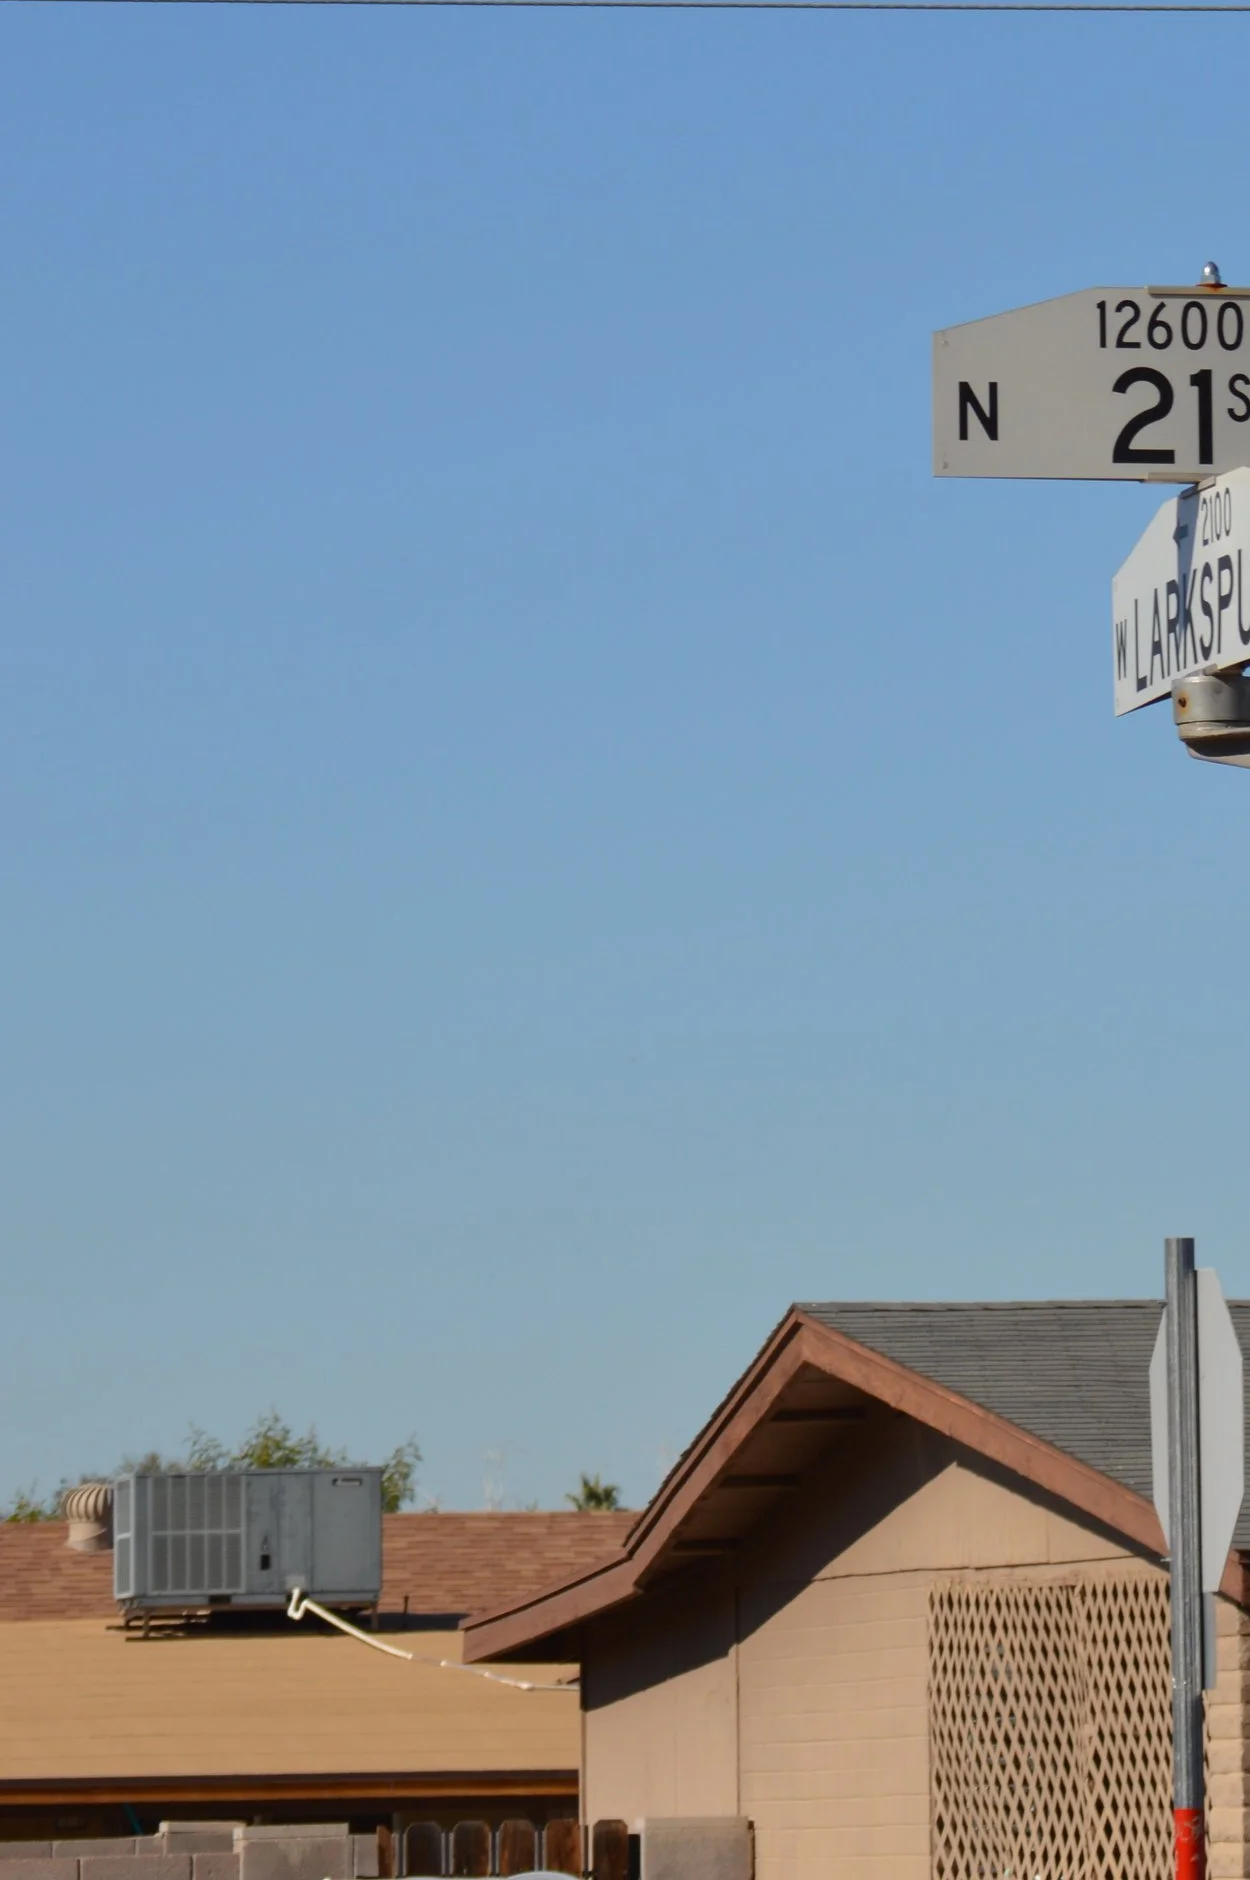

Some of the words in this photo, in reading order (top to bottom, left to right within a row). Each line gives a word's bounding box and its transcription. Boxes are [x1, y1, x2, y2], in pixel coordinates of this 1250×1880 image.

[1096, 300, 1244, 351] 12600
[957, 381, 998, 441] N
[1201, 487, 1232, 546] 2100
[1115, 619, 1127, 680] W
